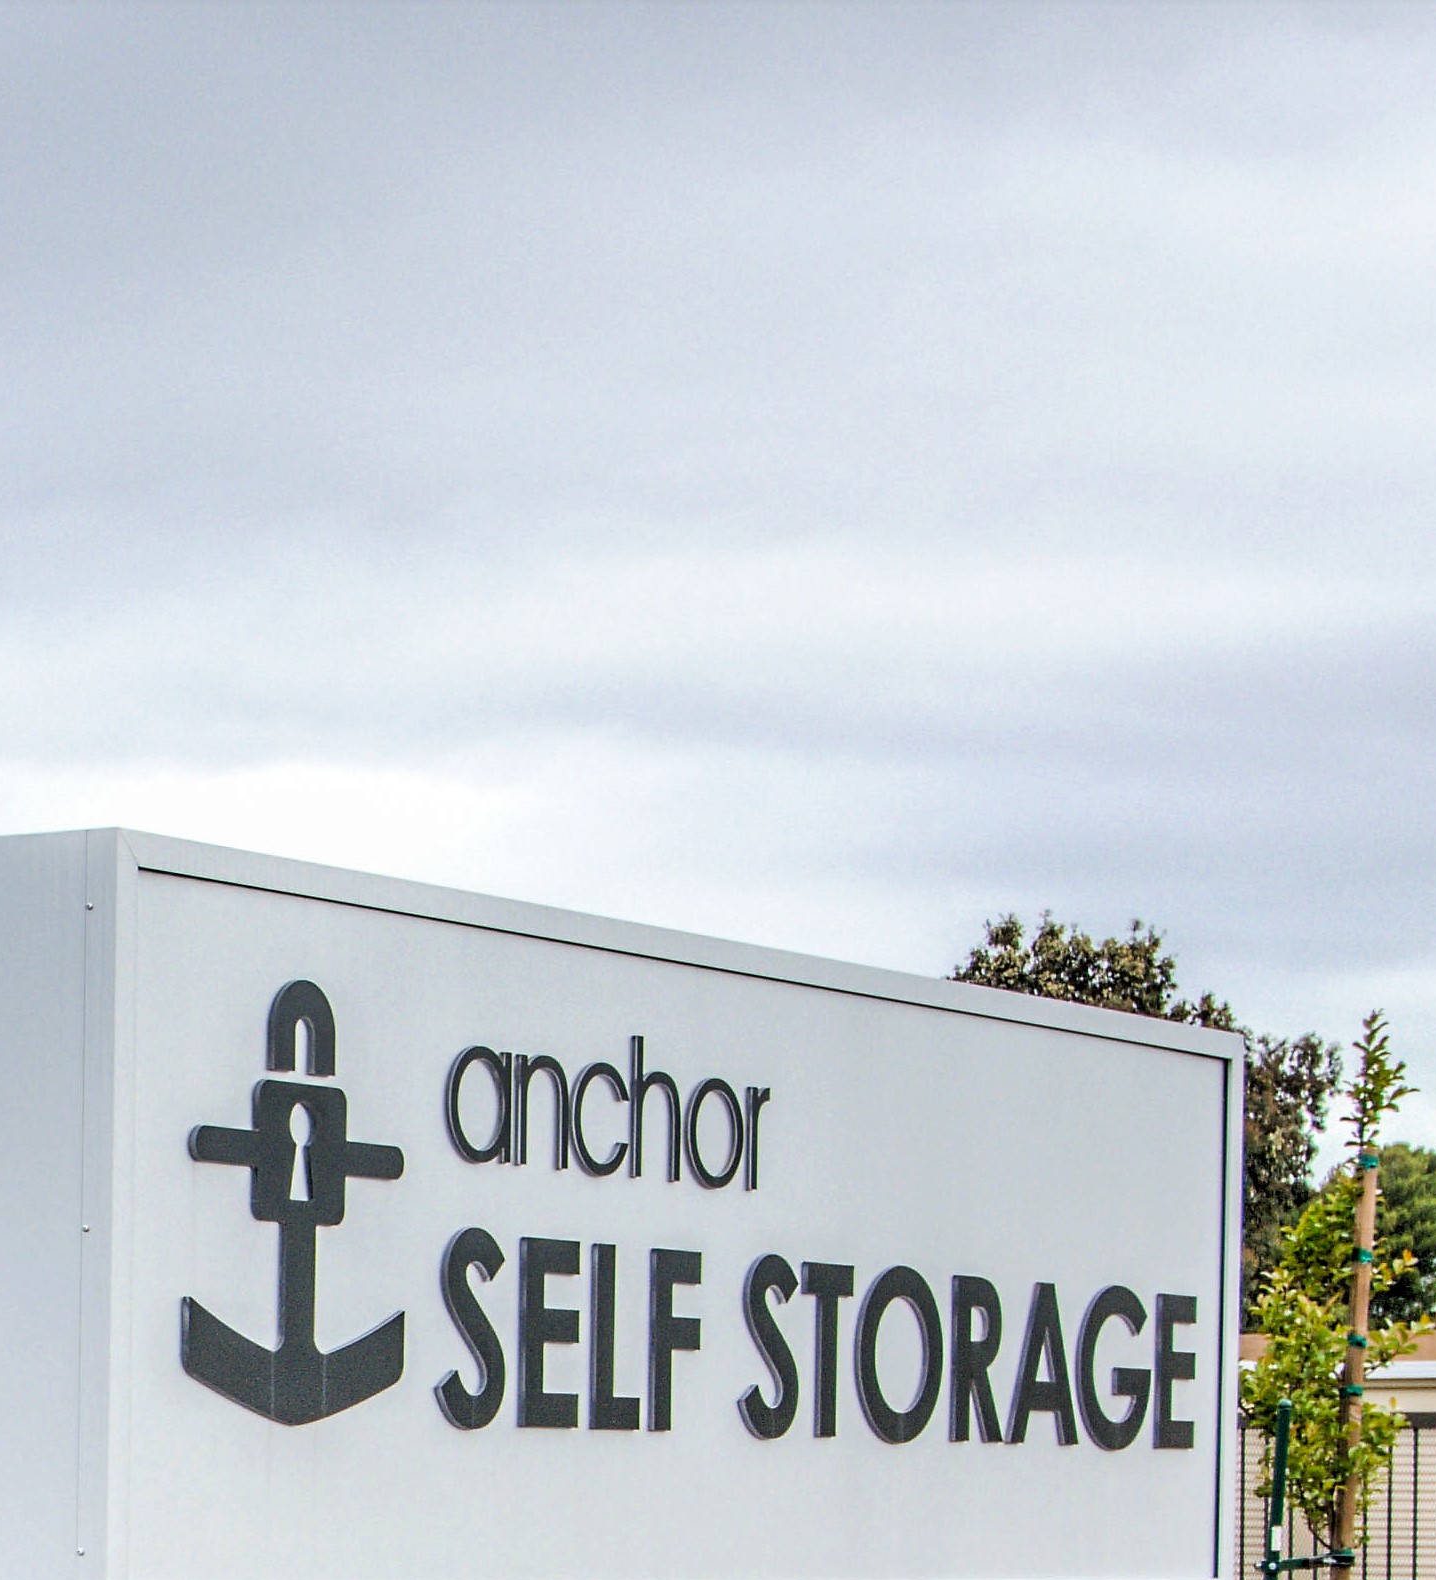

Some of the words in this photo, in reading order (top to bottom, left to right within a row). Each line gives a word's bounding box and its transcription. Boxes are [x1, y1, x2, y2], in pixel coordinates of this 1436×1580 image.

[446, 1034, 771, 1191] anchor
[433, 1226, 703, 1432] SELF
[736, 1251, 1198, 1451] STORAGE
